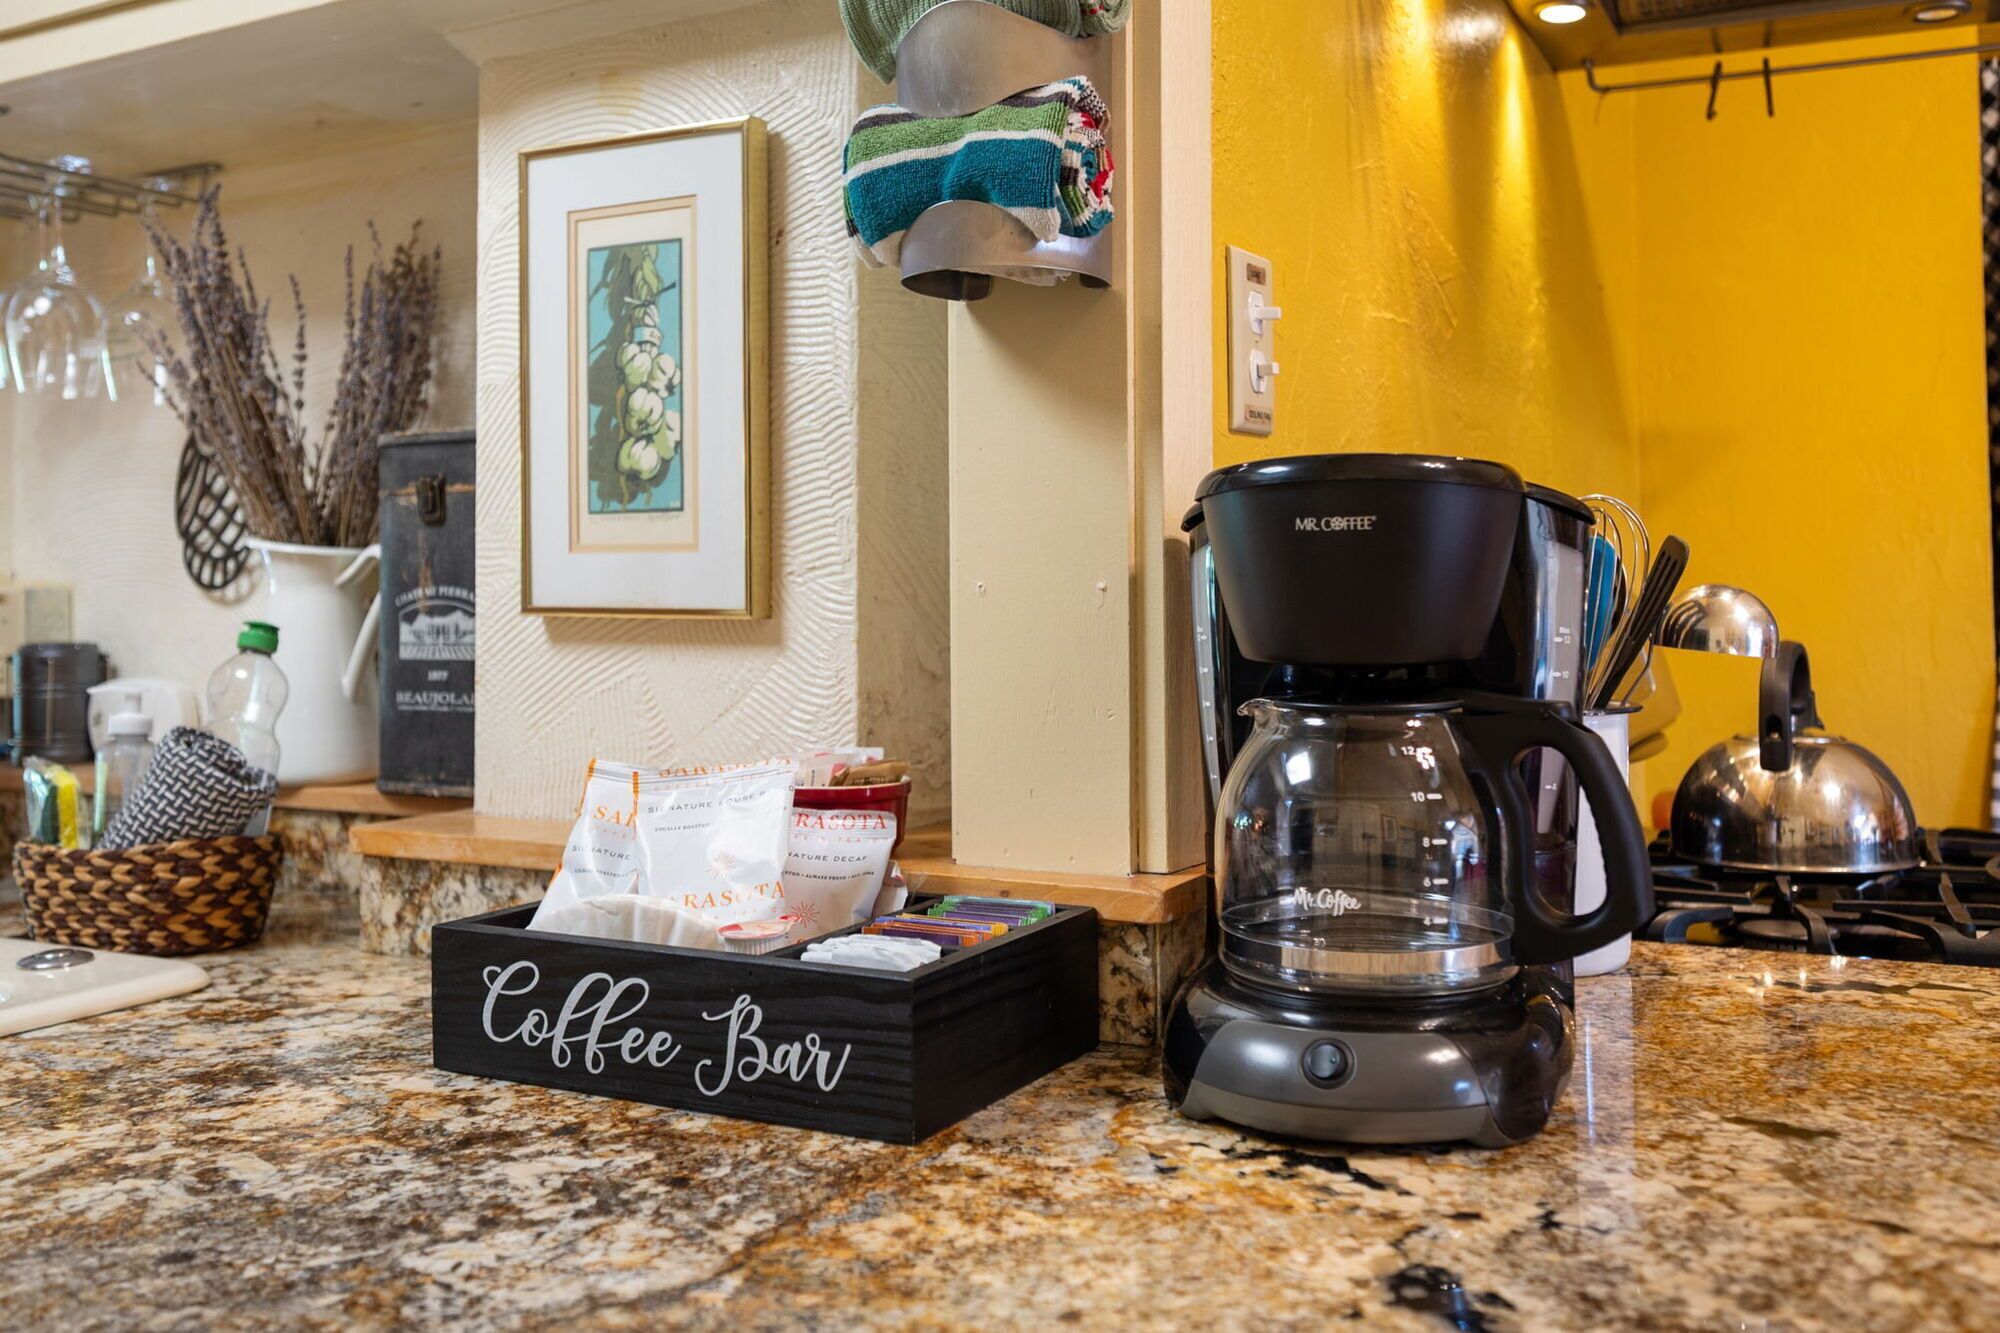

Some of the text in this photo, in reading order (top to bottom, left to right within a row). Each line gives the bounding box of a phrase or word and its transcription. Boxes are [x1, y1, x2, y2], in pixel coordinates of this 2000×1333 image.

[1295, 517, 1320, 531] MR.
[1401, 745, 1416, 755] 12
[648, 792, 754, 813] SINATURE OUSE
[1410, 791, 1425, 802] 10
[1422, 837, 1430, 847] 8
[572, 845, 633, 860] SIATURE
[1423, 876, 1431, 887] 6
[1317, 888, 1362, 917] Coffee
[1423, 916, 1431, 926] 4
[482, 960, 851, 1096] Coffee Bar
